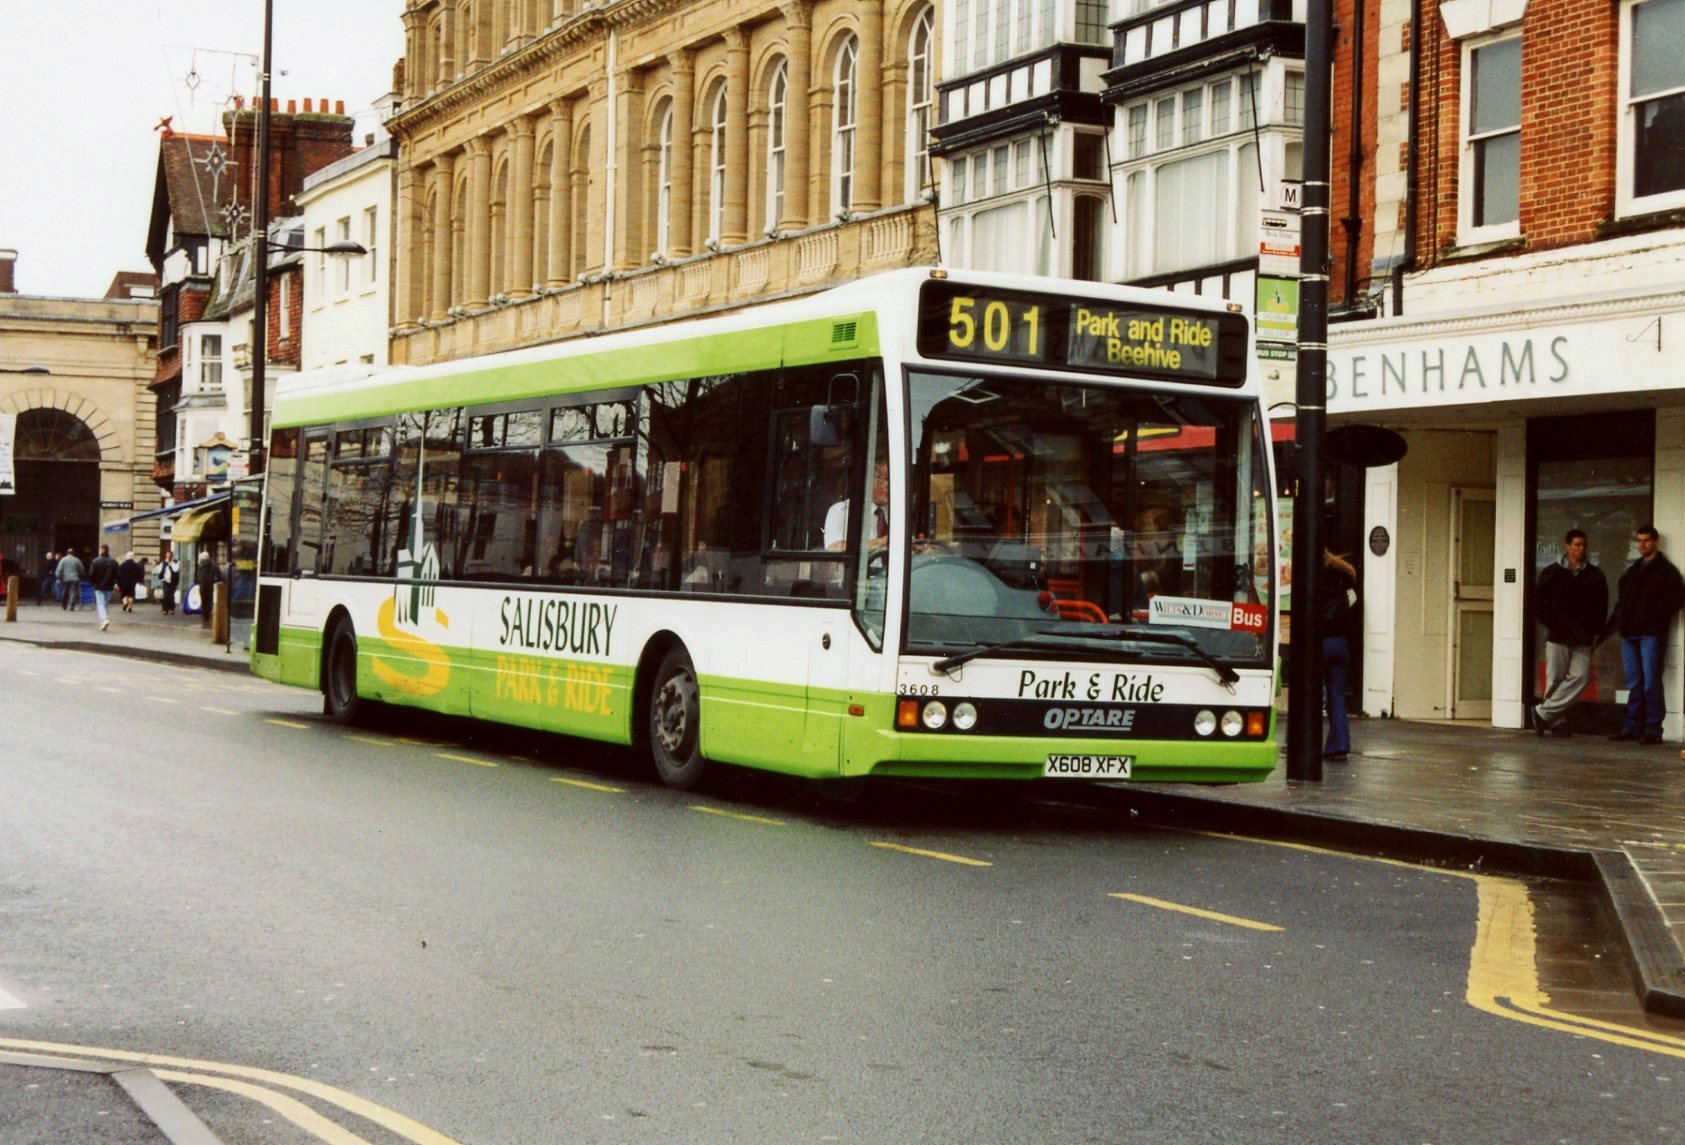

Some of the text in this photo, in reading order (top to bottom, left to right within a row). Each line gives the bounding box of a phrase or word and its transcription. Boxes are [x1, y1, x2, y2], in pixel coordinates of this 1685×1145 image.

[1284, 188, 1297, 203] M
[1076, 308, 1212, 347] Park and Ride
[1107, 338, 1182, 370] Beehive
[1270, 350, 1287, 358] STOP
[499, 595, 618, 657] SALISBURY
[1233, 607, 1263, 627] Bus
[496, 655, 614, 716] PARK & RIDE
[900, 683, 939, 696] 3608
[1018, 670, 1164, 702] Park & Ride
[1044, 708, 1136, 731] OPTARE
[1048, 756, 1129, 774] X608 XFX
